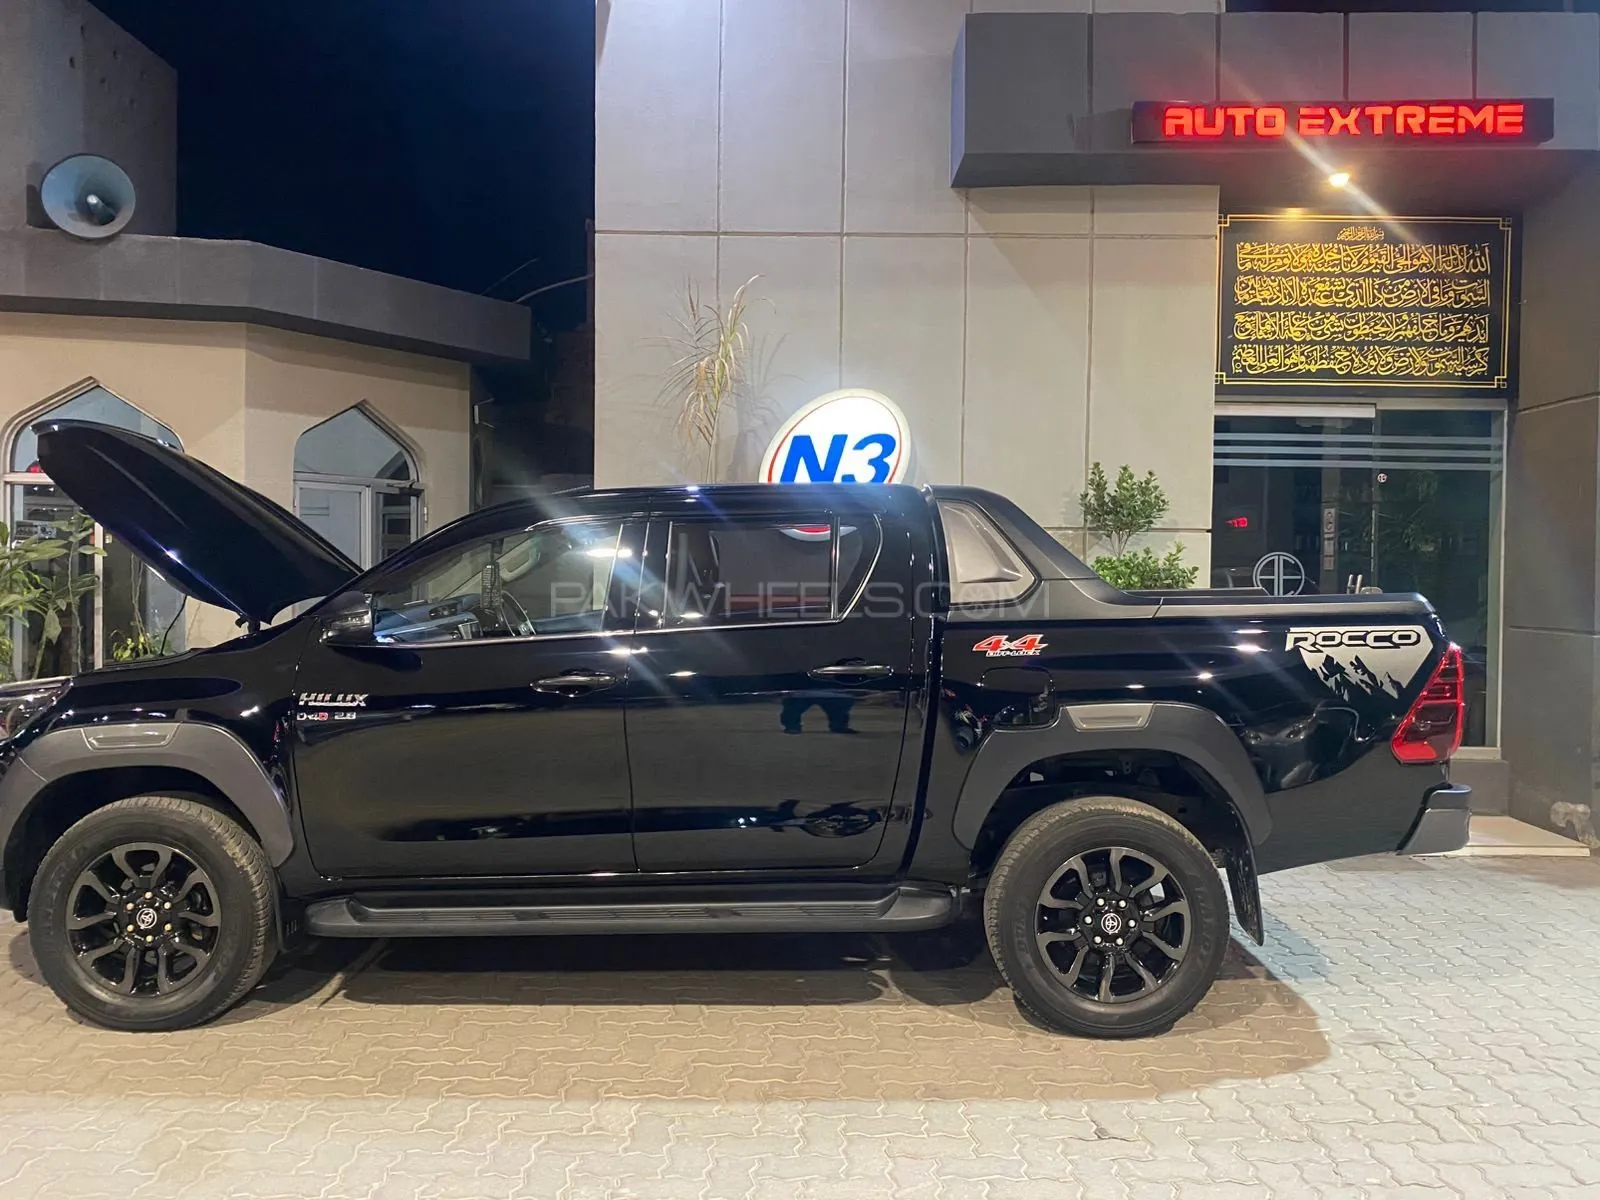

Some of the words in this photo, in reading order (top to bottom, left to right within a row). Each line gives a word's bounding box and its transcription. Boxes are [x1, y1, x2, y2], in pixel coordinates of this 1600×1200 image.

[1164, 107, 1286, 137] AUTO
[1298, 104, 1524, 136] EXTREME
[779, 433, 897, 483] N3
[1285, 630, 1421, 653] ROCCO
[298, 692, 369, 707] HILUX
